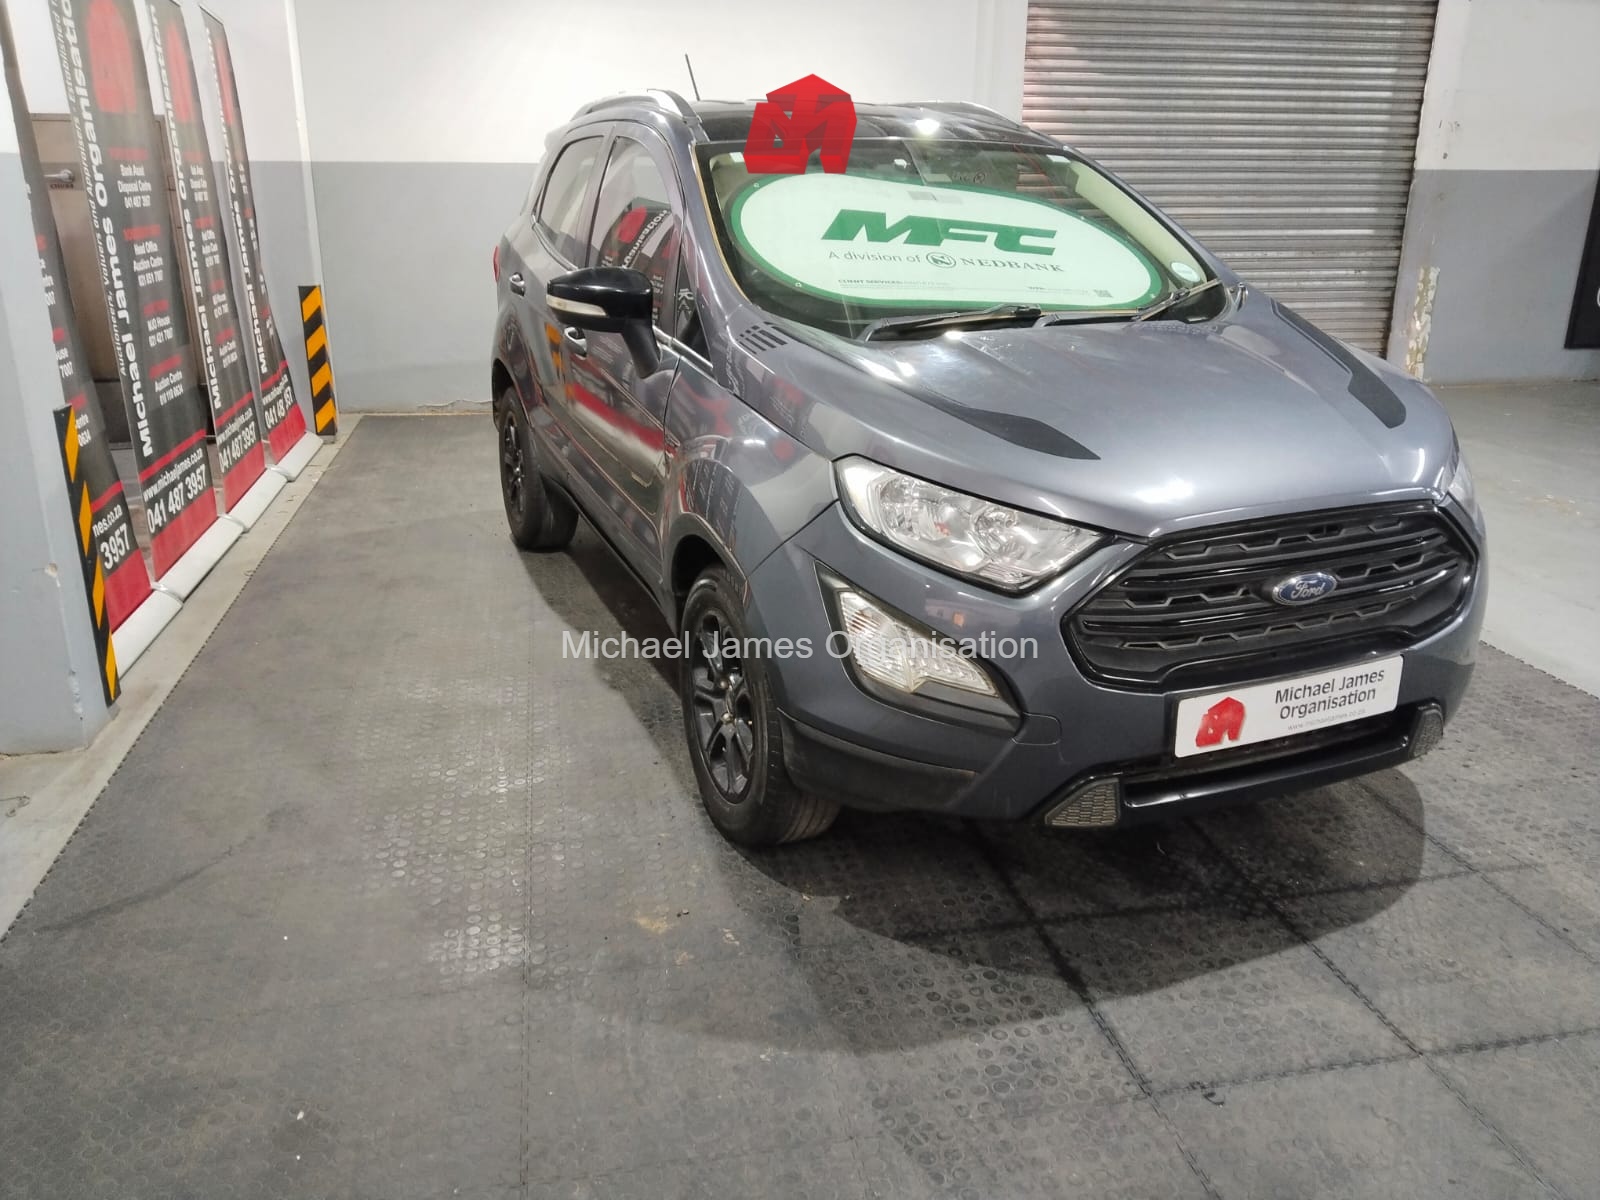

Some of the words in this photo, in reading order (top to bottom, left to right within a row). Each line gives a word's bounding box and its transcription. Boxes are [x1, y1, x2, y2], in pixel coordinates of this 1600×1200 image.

[183, 208, 204, 298] James
[233, 200, 251, 279] James
[821, 208, 1058, 256] MFC
[828, 251, 840, 260] A
[843, 251, 902, 263] division
[905, 255, 922, 264] of
[960, 258, 1064, 272] NEDBANK
[102, 216, 130, 325] James
[198, 305, 222, 409] Michael
[246, 283, 268, 374] Michael
[121, 332, 153, 457] Michael
[218, 440, 233, 473] 041
[231, 434, 244, 461] 487
[146, 498, 167, 533] 041
[168, 481, 186, 515] 487
[185, 463, 208, 499] 3957
[100, 522, 131, 570] 3957
[1291, 580, 1326, 600] Ford
[1275, 678, 1335, 704] Michael
[1338, 669, 1385, 691] James
[1280, 687, 1376, 719] Organisation
